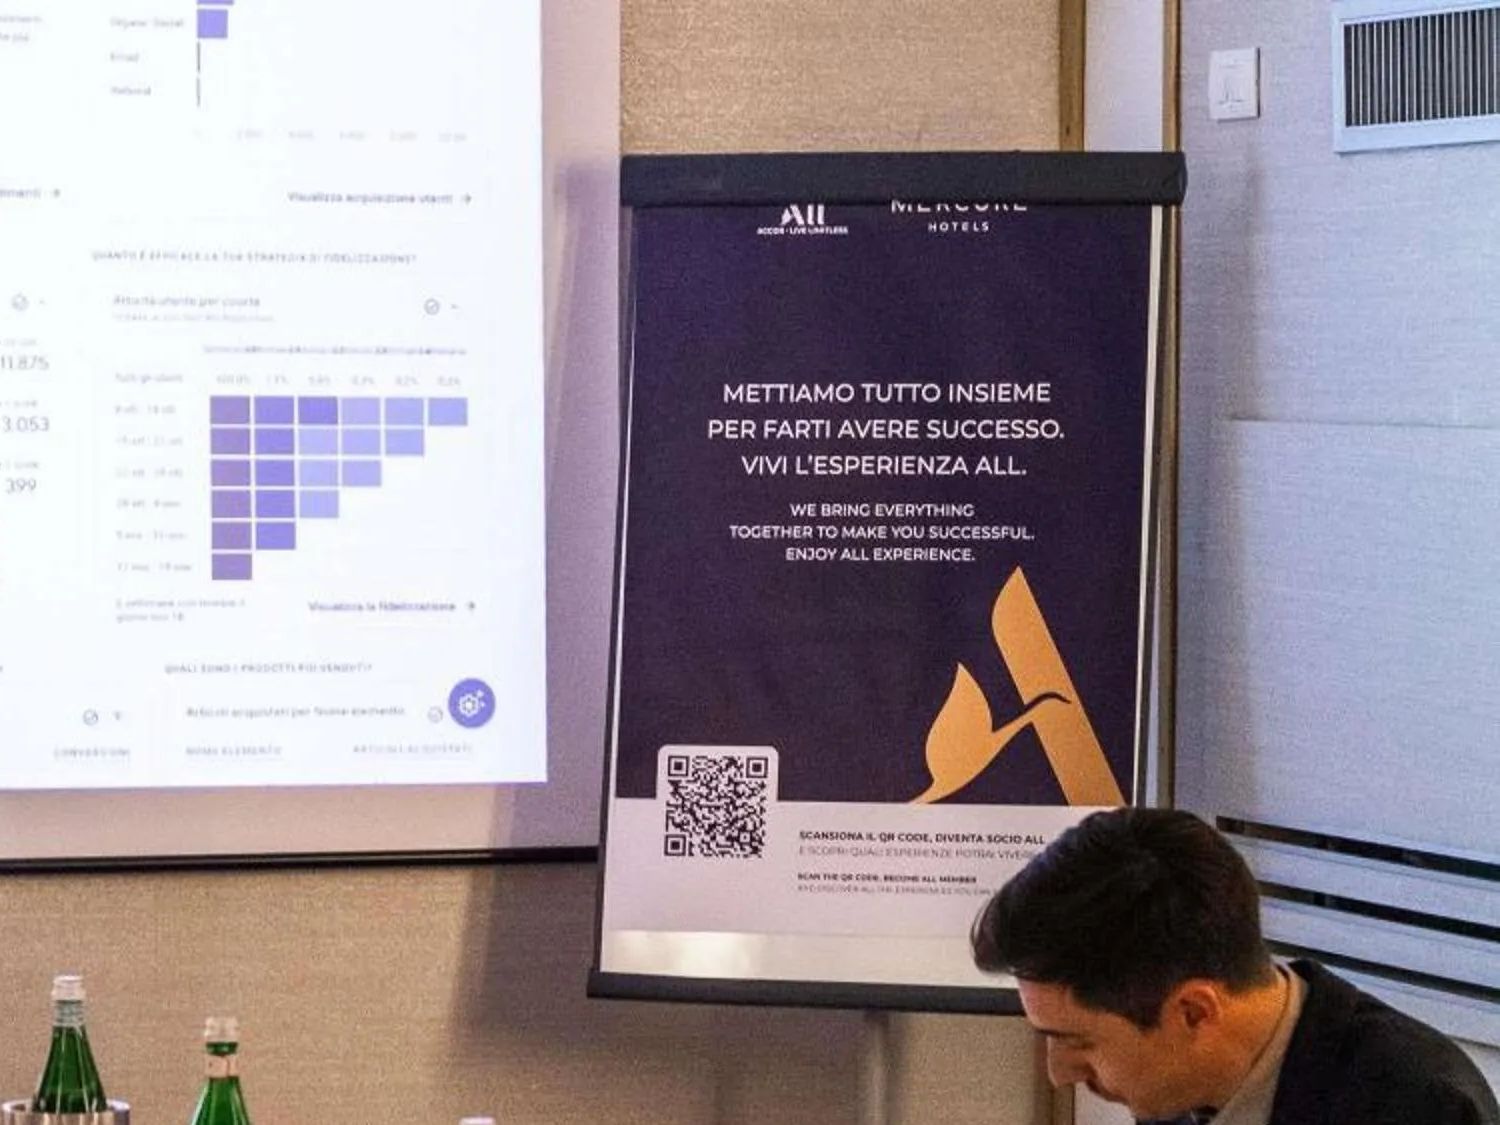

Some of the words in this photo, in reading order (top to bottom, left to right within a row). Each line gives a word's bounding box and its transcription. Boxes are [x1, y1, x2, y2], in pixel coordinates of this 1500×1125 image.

[927, 221, 990, 233] HOTELS
[0, 355, 50, 372] 11.875
[722, 383, 856, 403] METTIAMO
[861, 383, 942, 403] TUTTO
[948, 383, 1052, 403] INSIEME
[1, 416, 51, 434] 3.053
[707, 419, 756, 439] PER
[763, 419, 831, 439] FARTI
[837, 419, 920, 439] AVERE
[926, 419, 1066, 440] SUCCESSO.
[741, 455, 789, 476] VIVI
[795, 453, 969, 476] L'ESPERIENZA
[974, 455, 1028, 476] ALL.
[4, 477, 38, 496] 399
[790, 503, 817, 517] WE
[821, 503, 871, 518] BRING
[874, 503, 975, 518] EVERYTHING
[729, 525, 813, 540] TOGETHER
[816, 525, 838, 540] TO
[841, 525, 888, 540] MAKE
[891, 525, 926, 540] YOU
[928, 525, 1036, 540] SUCCESSFUL.
[785, 547, 837, 562] ENJOY
[840, 547, 870, 561] ALL
[872, 547, 977, 562] EXPERIENCE.
[799, 830, 864, 843] SCANSIONA
[865, 832, 877, 842] IL
[878, 831, 896, 844] QR
[897, 832, 933, 844] CODE,
[935, 833, 984, 844] DIVENTA
[986, 834, 1023, 844] SOCIO
[1023, 834, 1046, 845] ALL
[938, 875, 978, 885] MEMBER
